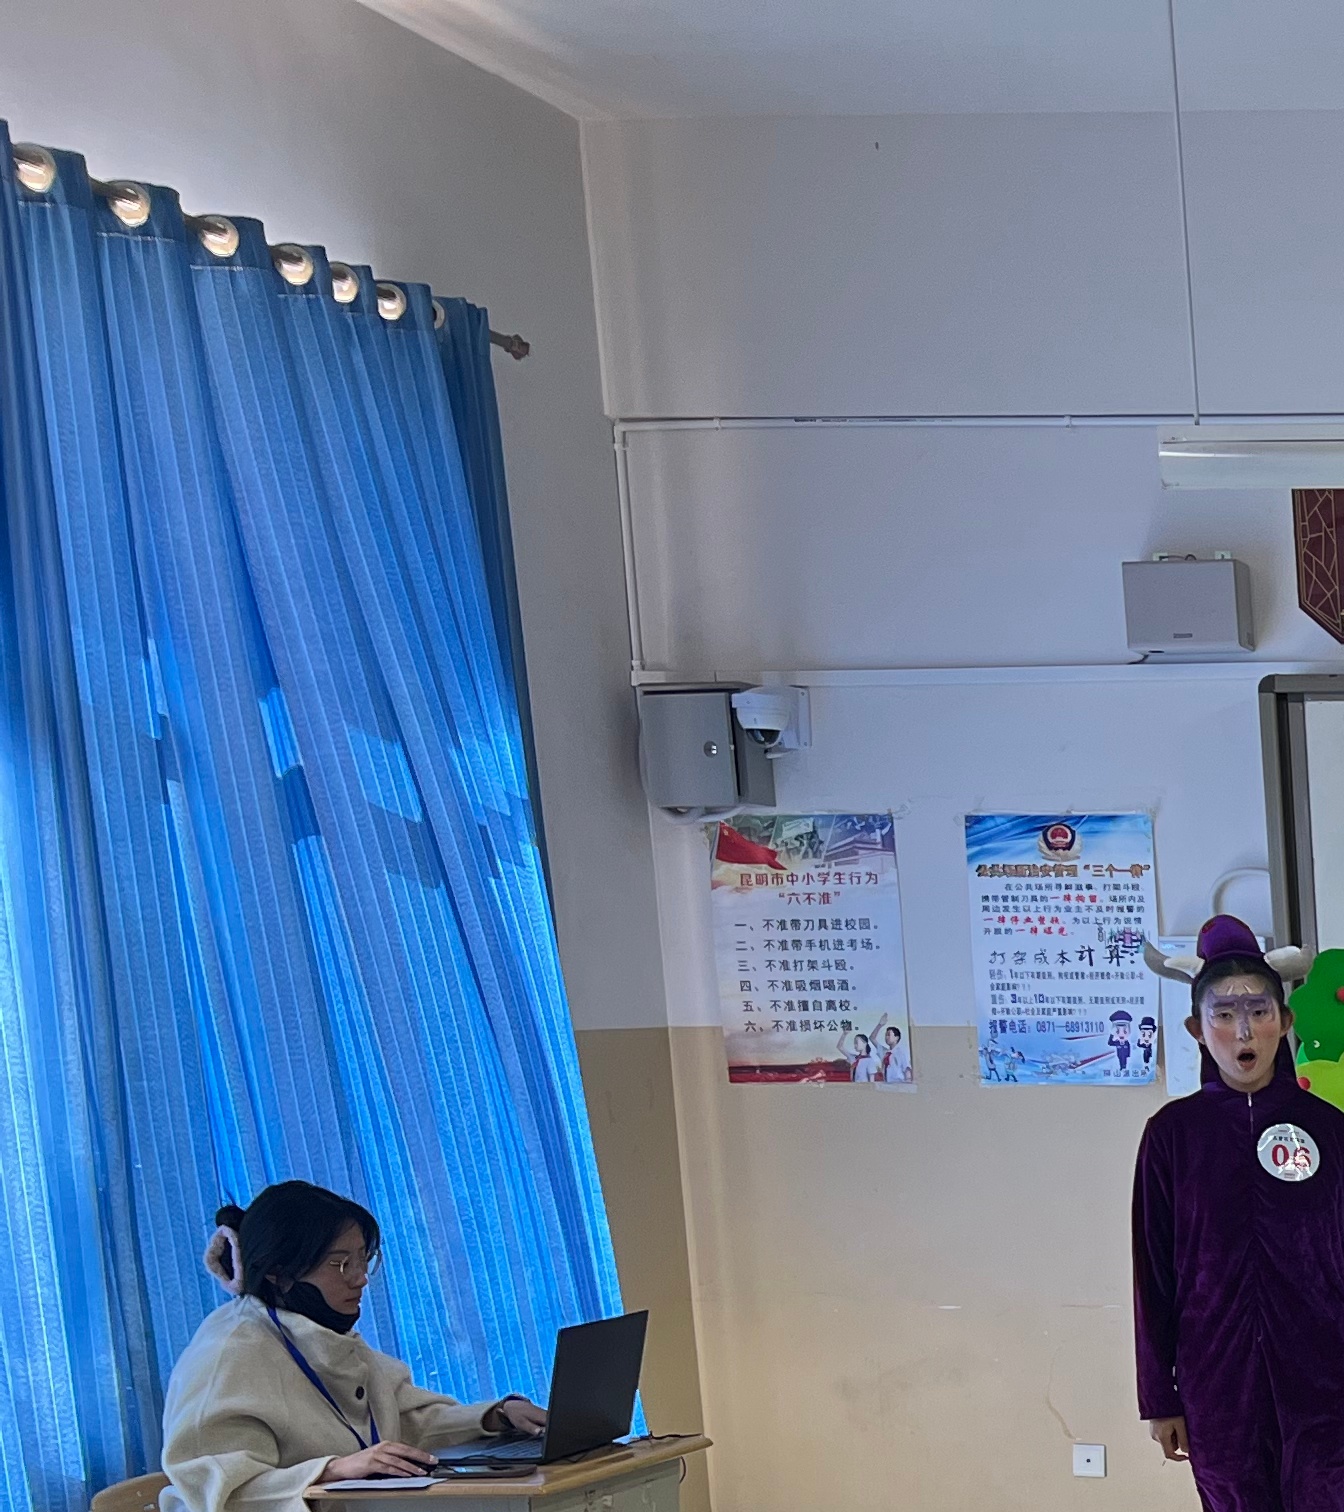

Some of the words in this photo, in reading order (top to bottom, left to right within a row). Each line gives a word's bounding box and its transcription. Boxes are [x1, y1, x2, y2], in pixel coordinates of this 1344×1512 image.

[740, 871, 879, 886] 昆明市中小学生行为
[779, 891, 841, 905] “六不准”
